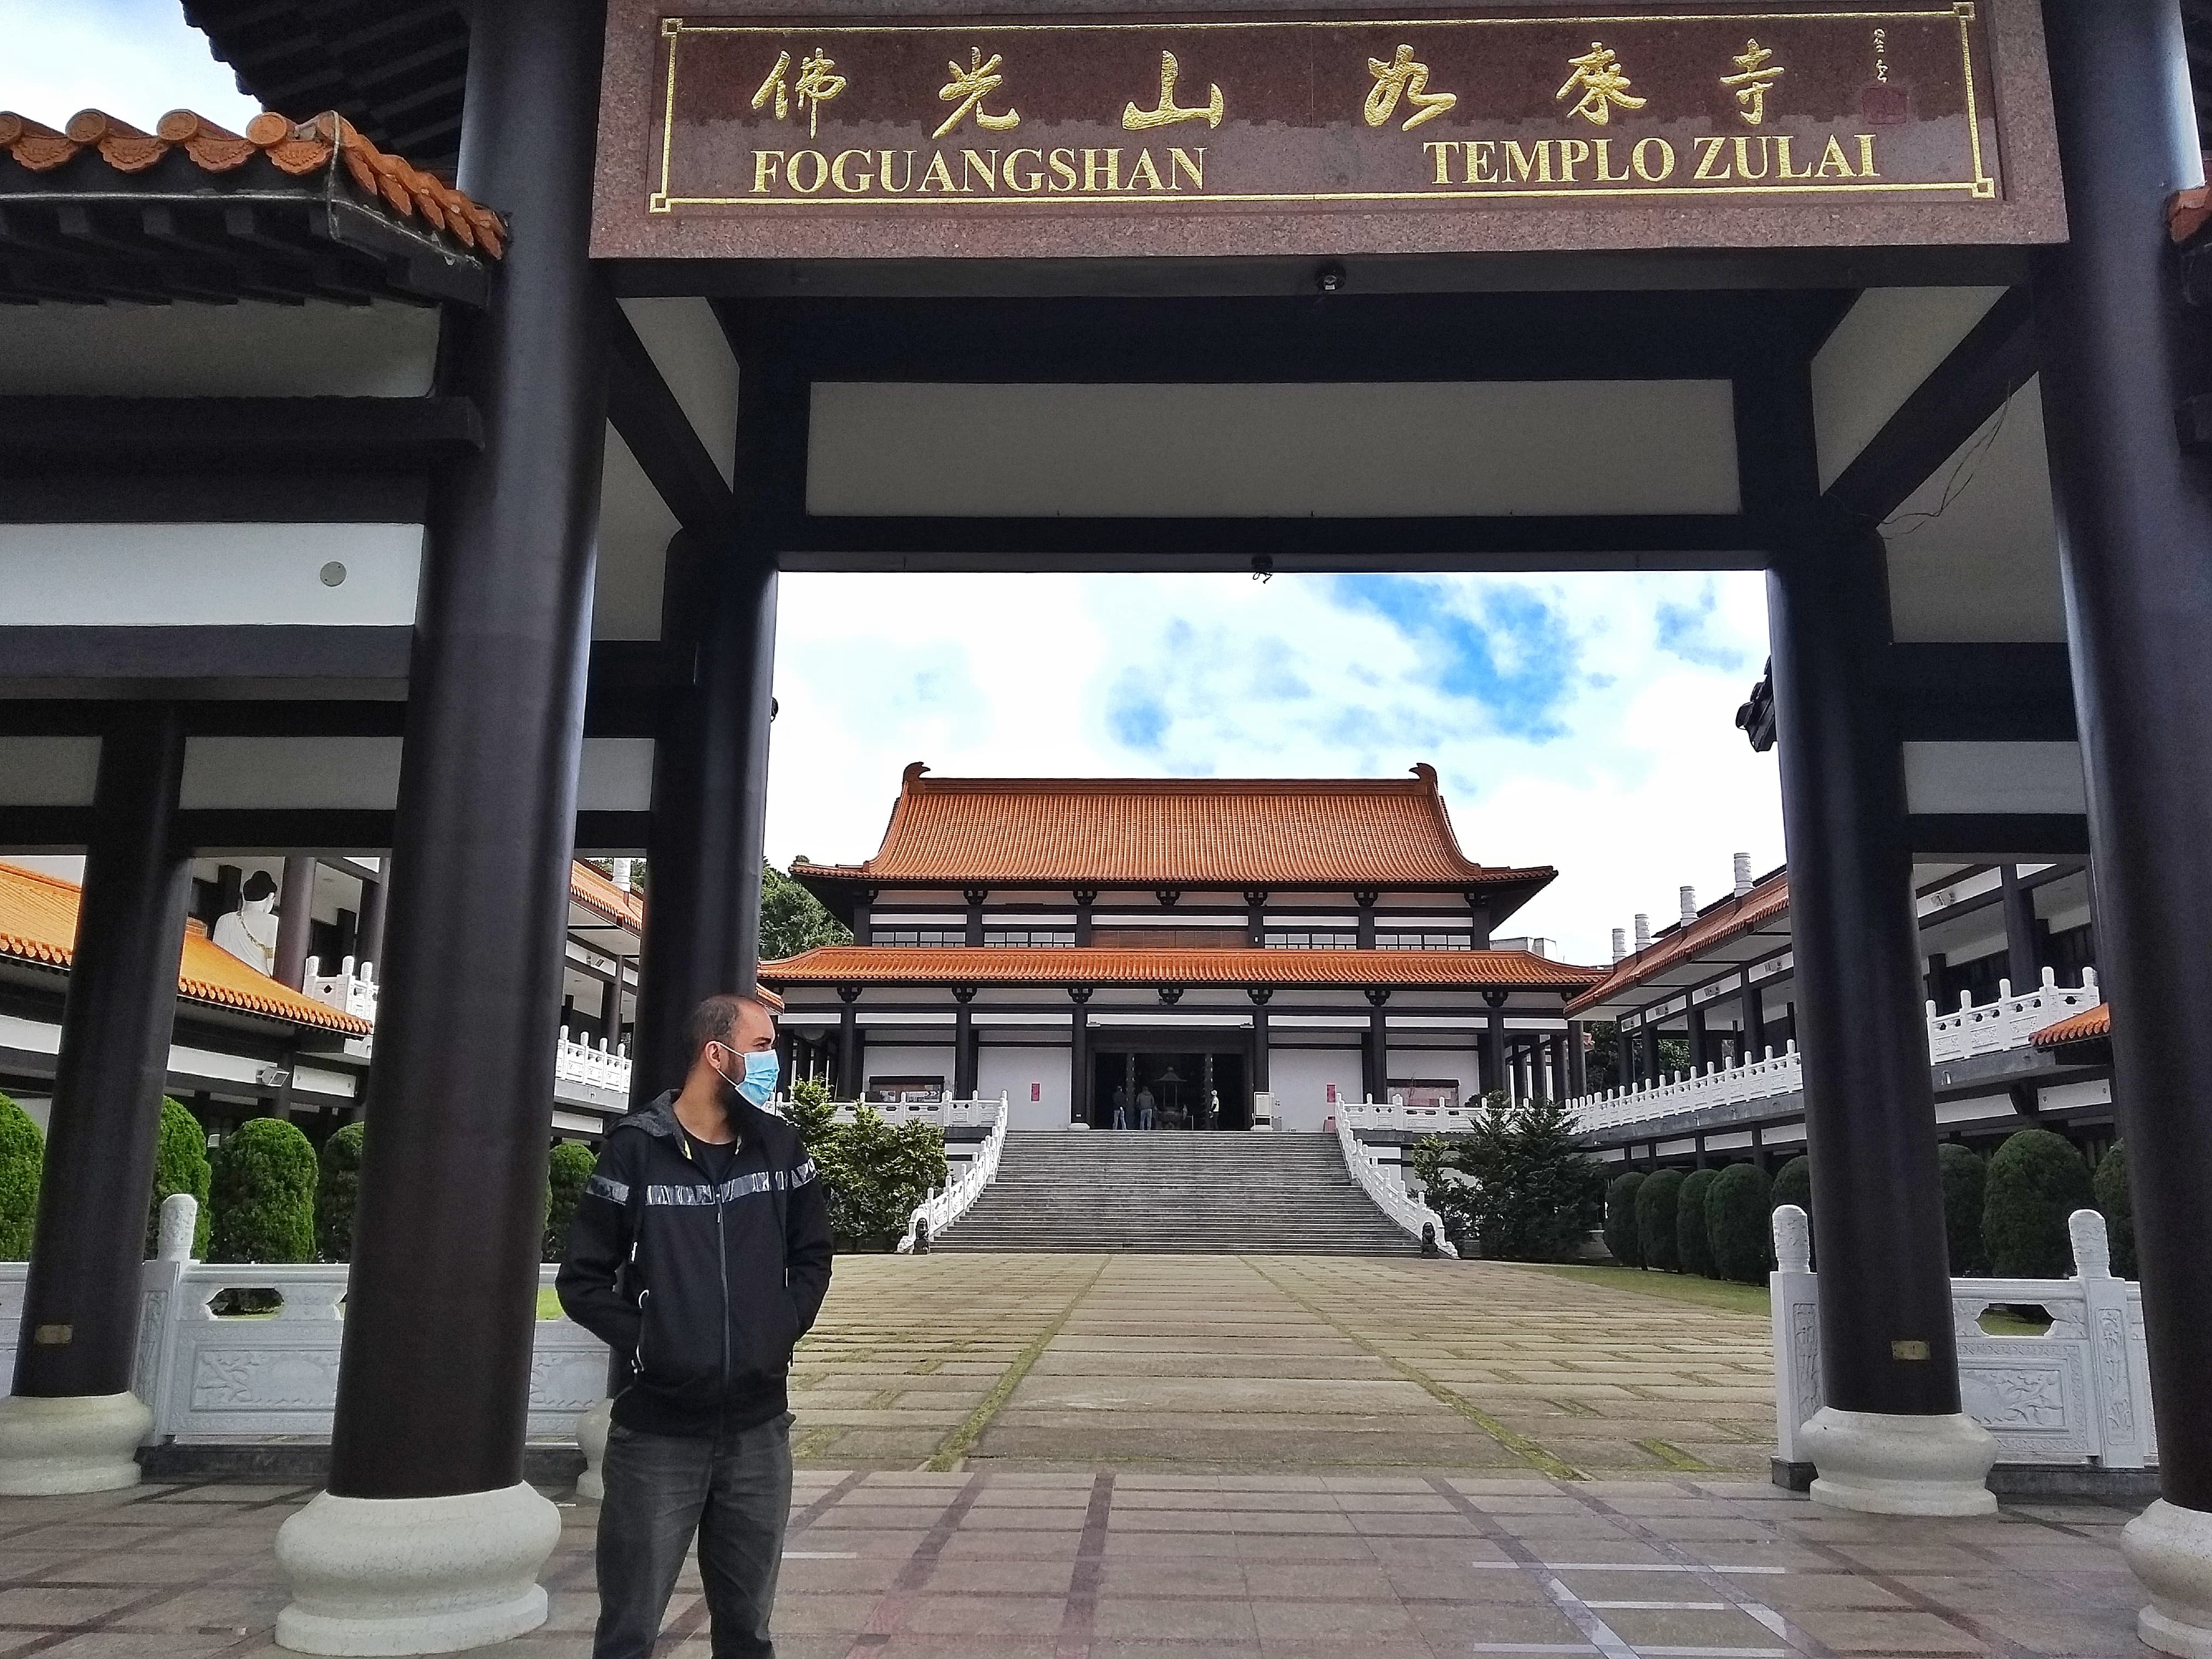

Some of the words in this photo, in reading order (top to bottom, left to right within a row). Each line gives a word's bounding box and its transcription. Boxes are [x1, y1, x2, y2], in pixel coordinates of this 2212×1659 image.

[749, 146, 1206, 194] FOGUANGSHAN
[1421, 137, 1677, 186] TEMPLO
[1691, 133, 1880, 181] ZULAI
